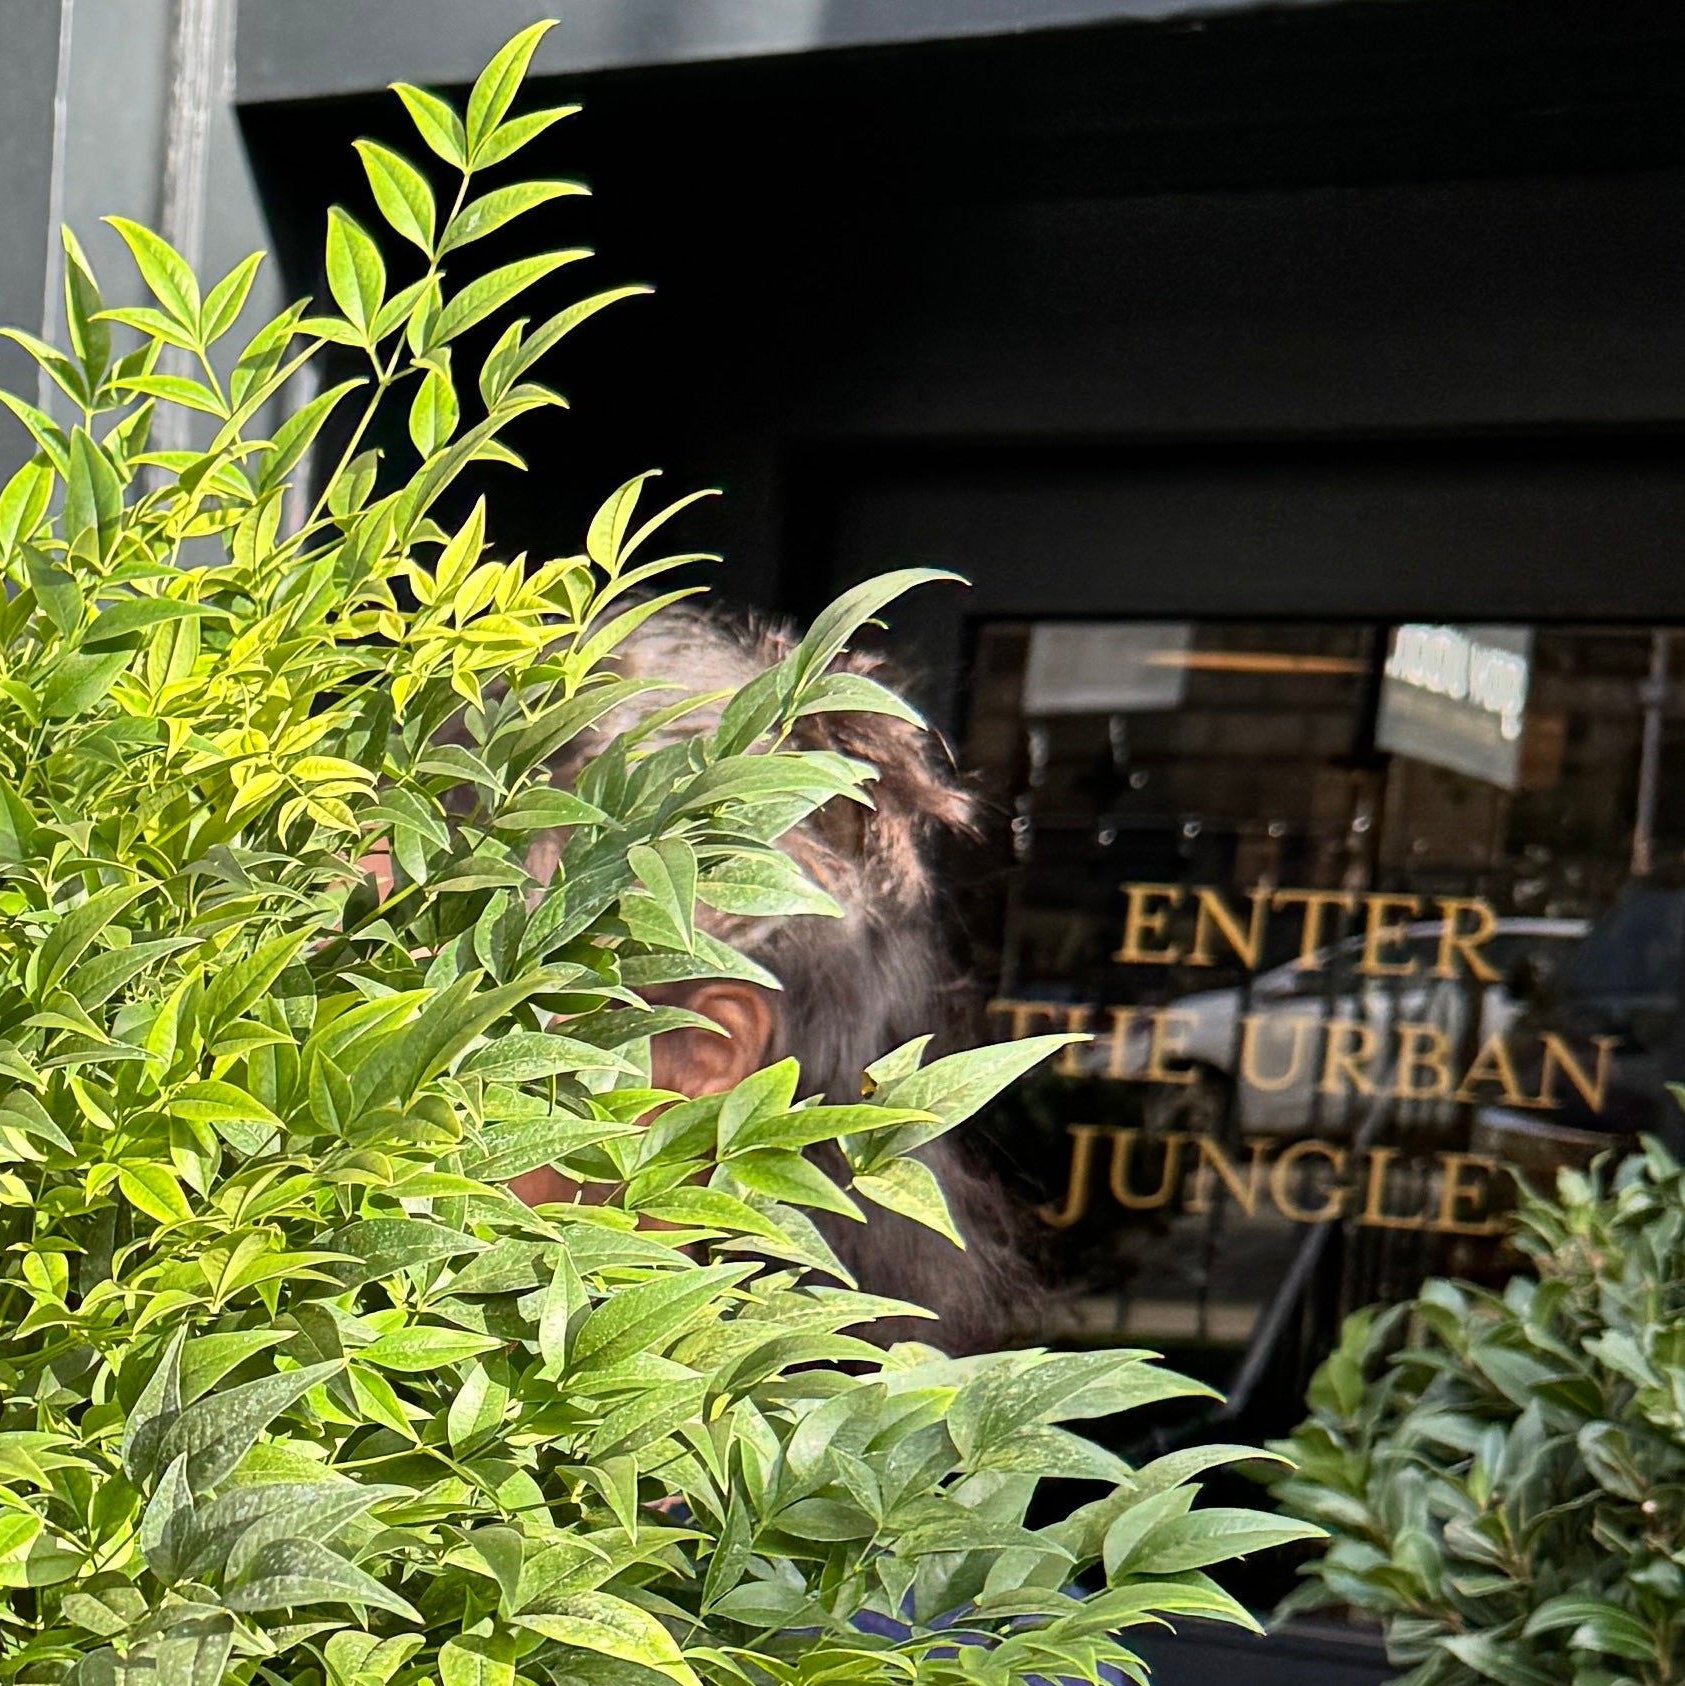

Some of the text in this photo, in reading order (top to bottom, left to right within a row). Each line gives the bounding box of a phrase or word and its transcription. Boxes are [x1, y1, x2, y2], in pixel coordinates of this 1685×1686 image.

[1114, 881, 1502, 982] ENTER
[986, 998, 1617, 1114] THE URBAN
[1037, 1124, 1516, 1237] JUNGLE
